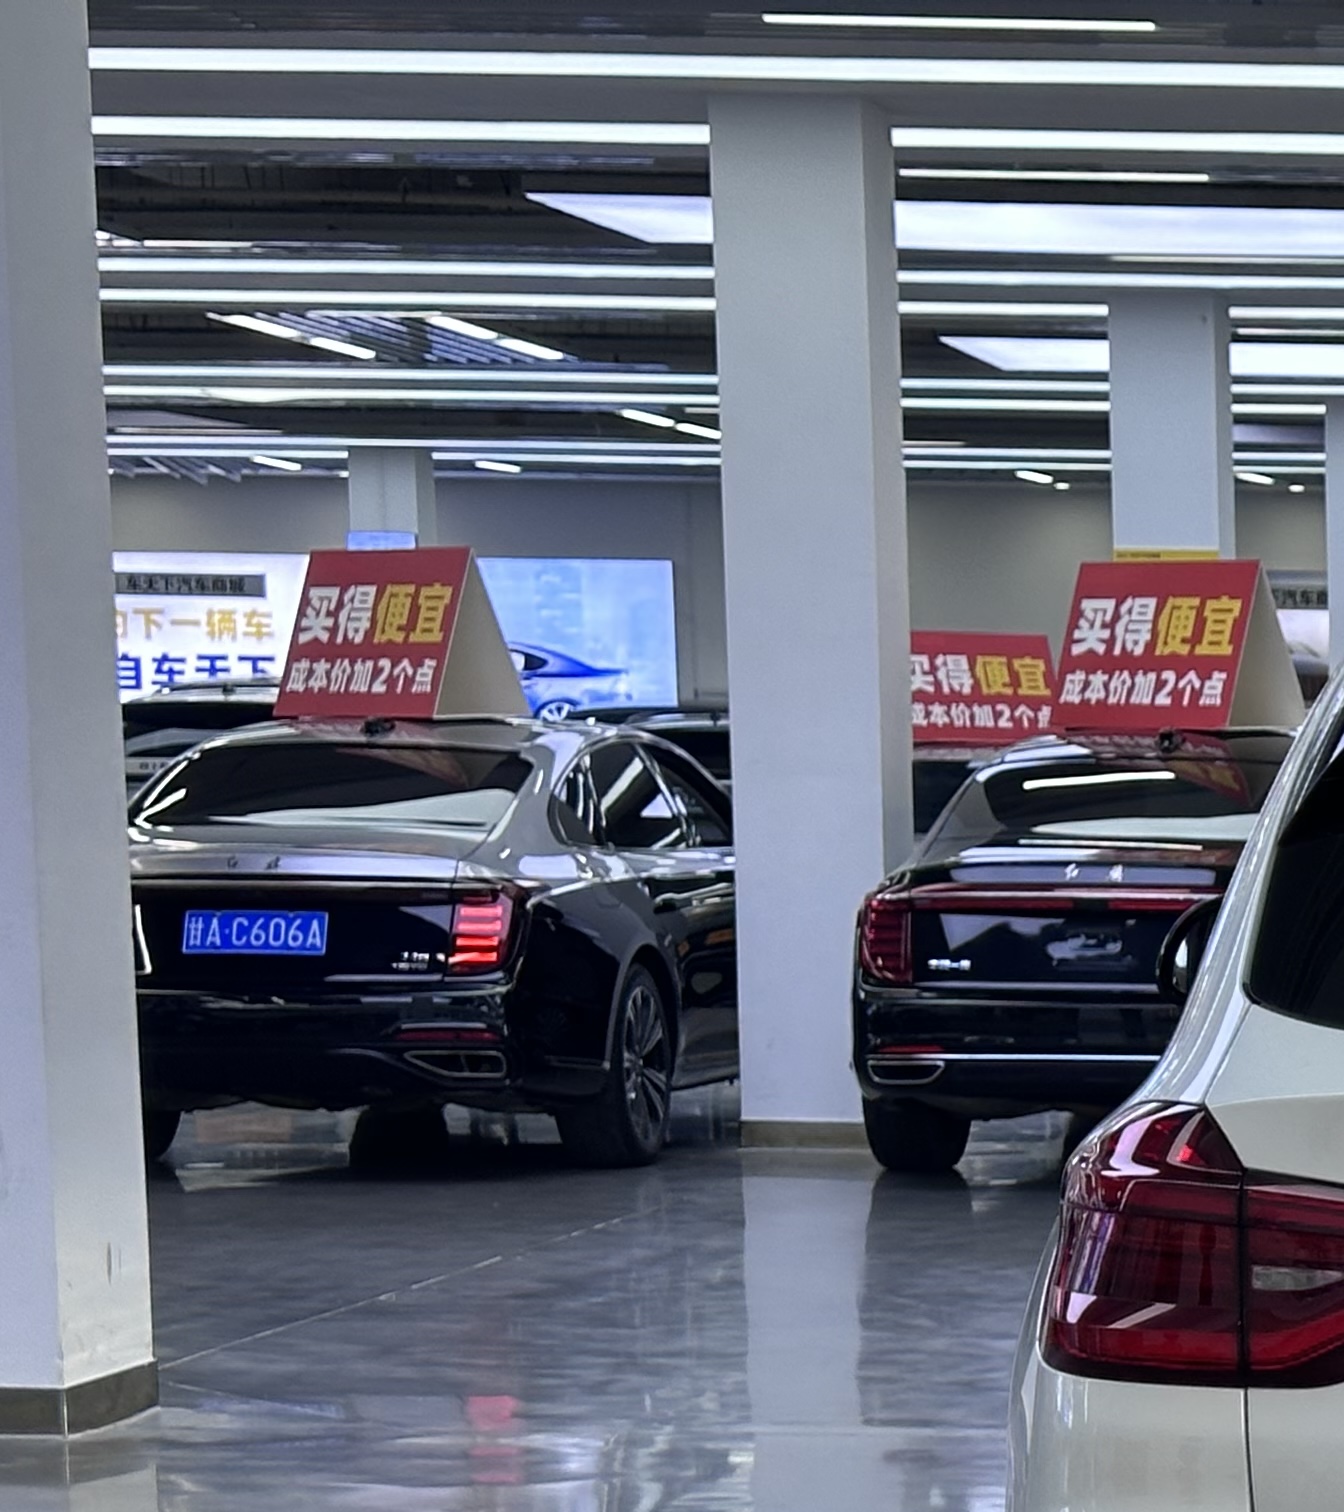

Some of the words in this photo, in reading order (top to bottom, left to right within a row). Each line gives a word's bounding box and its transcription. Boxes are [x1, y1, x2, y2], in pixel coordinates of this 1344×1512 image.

[298, 582, 453, 645] 买得便宜
[1071, 595, 1242, 656] 买得便宜
[286, 658, 437, 694] 成本价加2个点
[1059, 669, 1227, 708] 成本价加2个点
